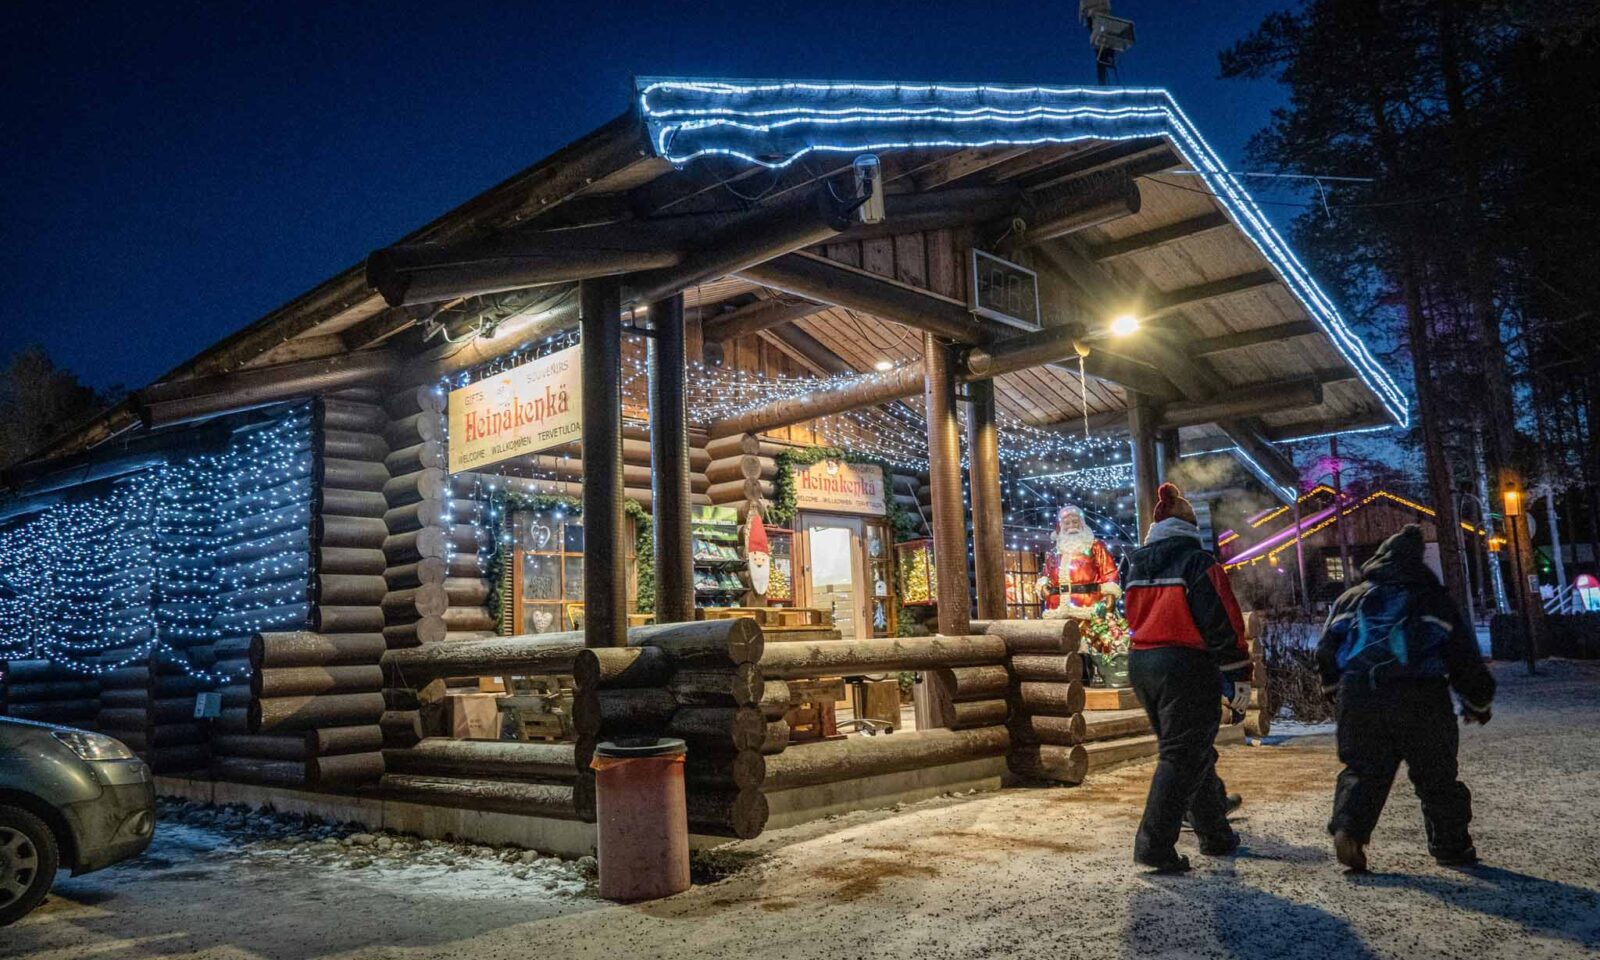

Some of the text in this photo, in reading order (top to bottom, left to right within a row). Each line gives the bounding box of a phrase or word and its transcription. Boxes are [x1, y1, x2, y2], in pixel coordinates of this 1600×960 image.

[465, 360, 569, 405] GIFTS SOUVENIRS
[464, 384, 569, 443] Heinäkenkä
[458, 421, 581, 464] WELCOME WILLKOMMEN TERVETULOA
